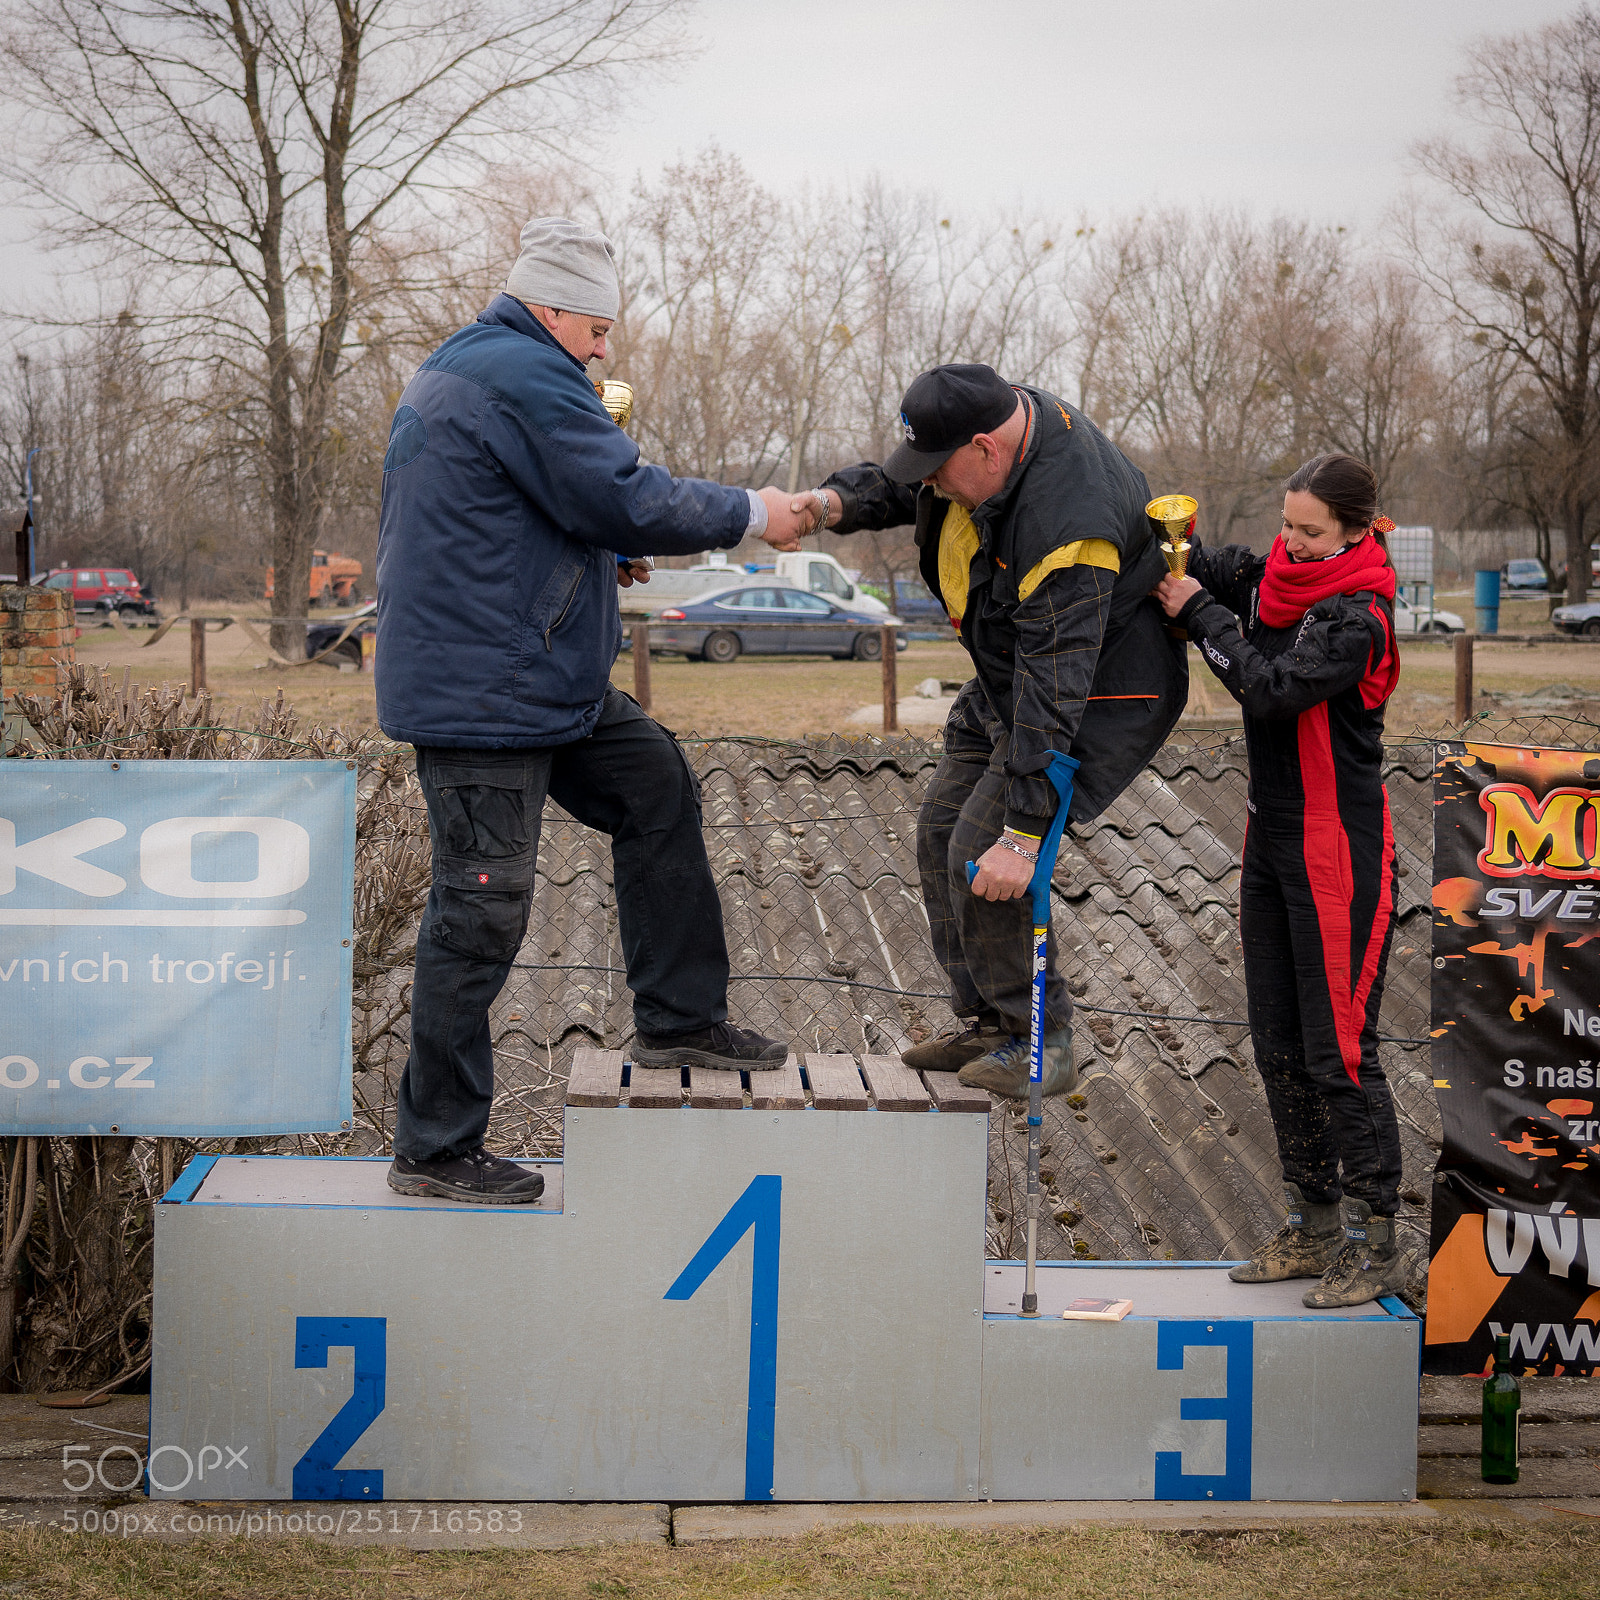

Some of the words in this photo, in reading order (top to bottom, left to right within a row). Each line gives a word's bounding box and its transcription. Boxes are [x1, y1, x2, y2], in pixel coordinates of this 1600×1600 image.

[1477, 884, 1600, 919] SVĚ
[149, 951, 306, 990] trofejí.
[1030, 984, 1041, 1078] MICHELIN
[0, 1055, 155, 1089] o.cz
[1503, 1059, 1525, 1087] S
[1567, 1120, 1600, 1141] zr
[662, 1175, 782, 1500] 1
[293, 1317, 387, 1500] 2
[1154, 1321, 1253, 1500] 3
